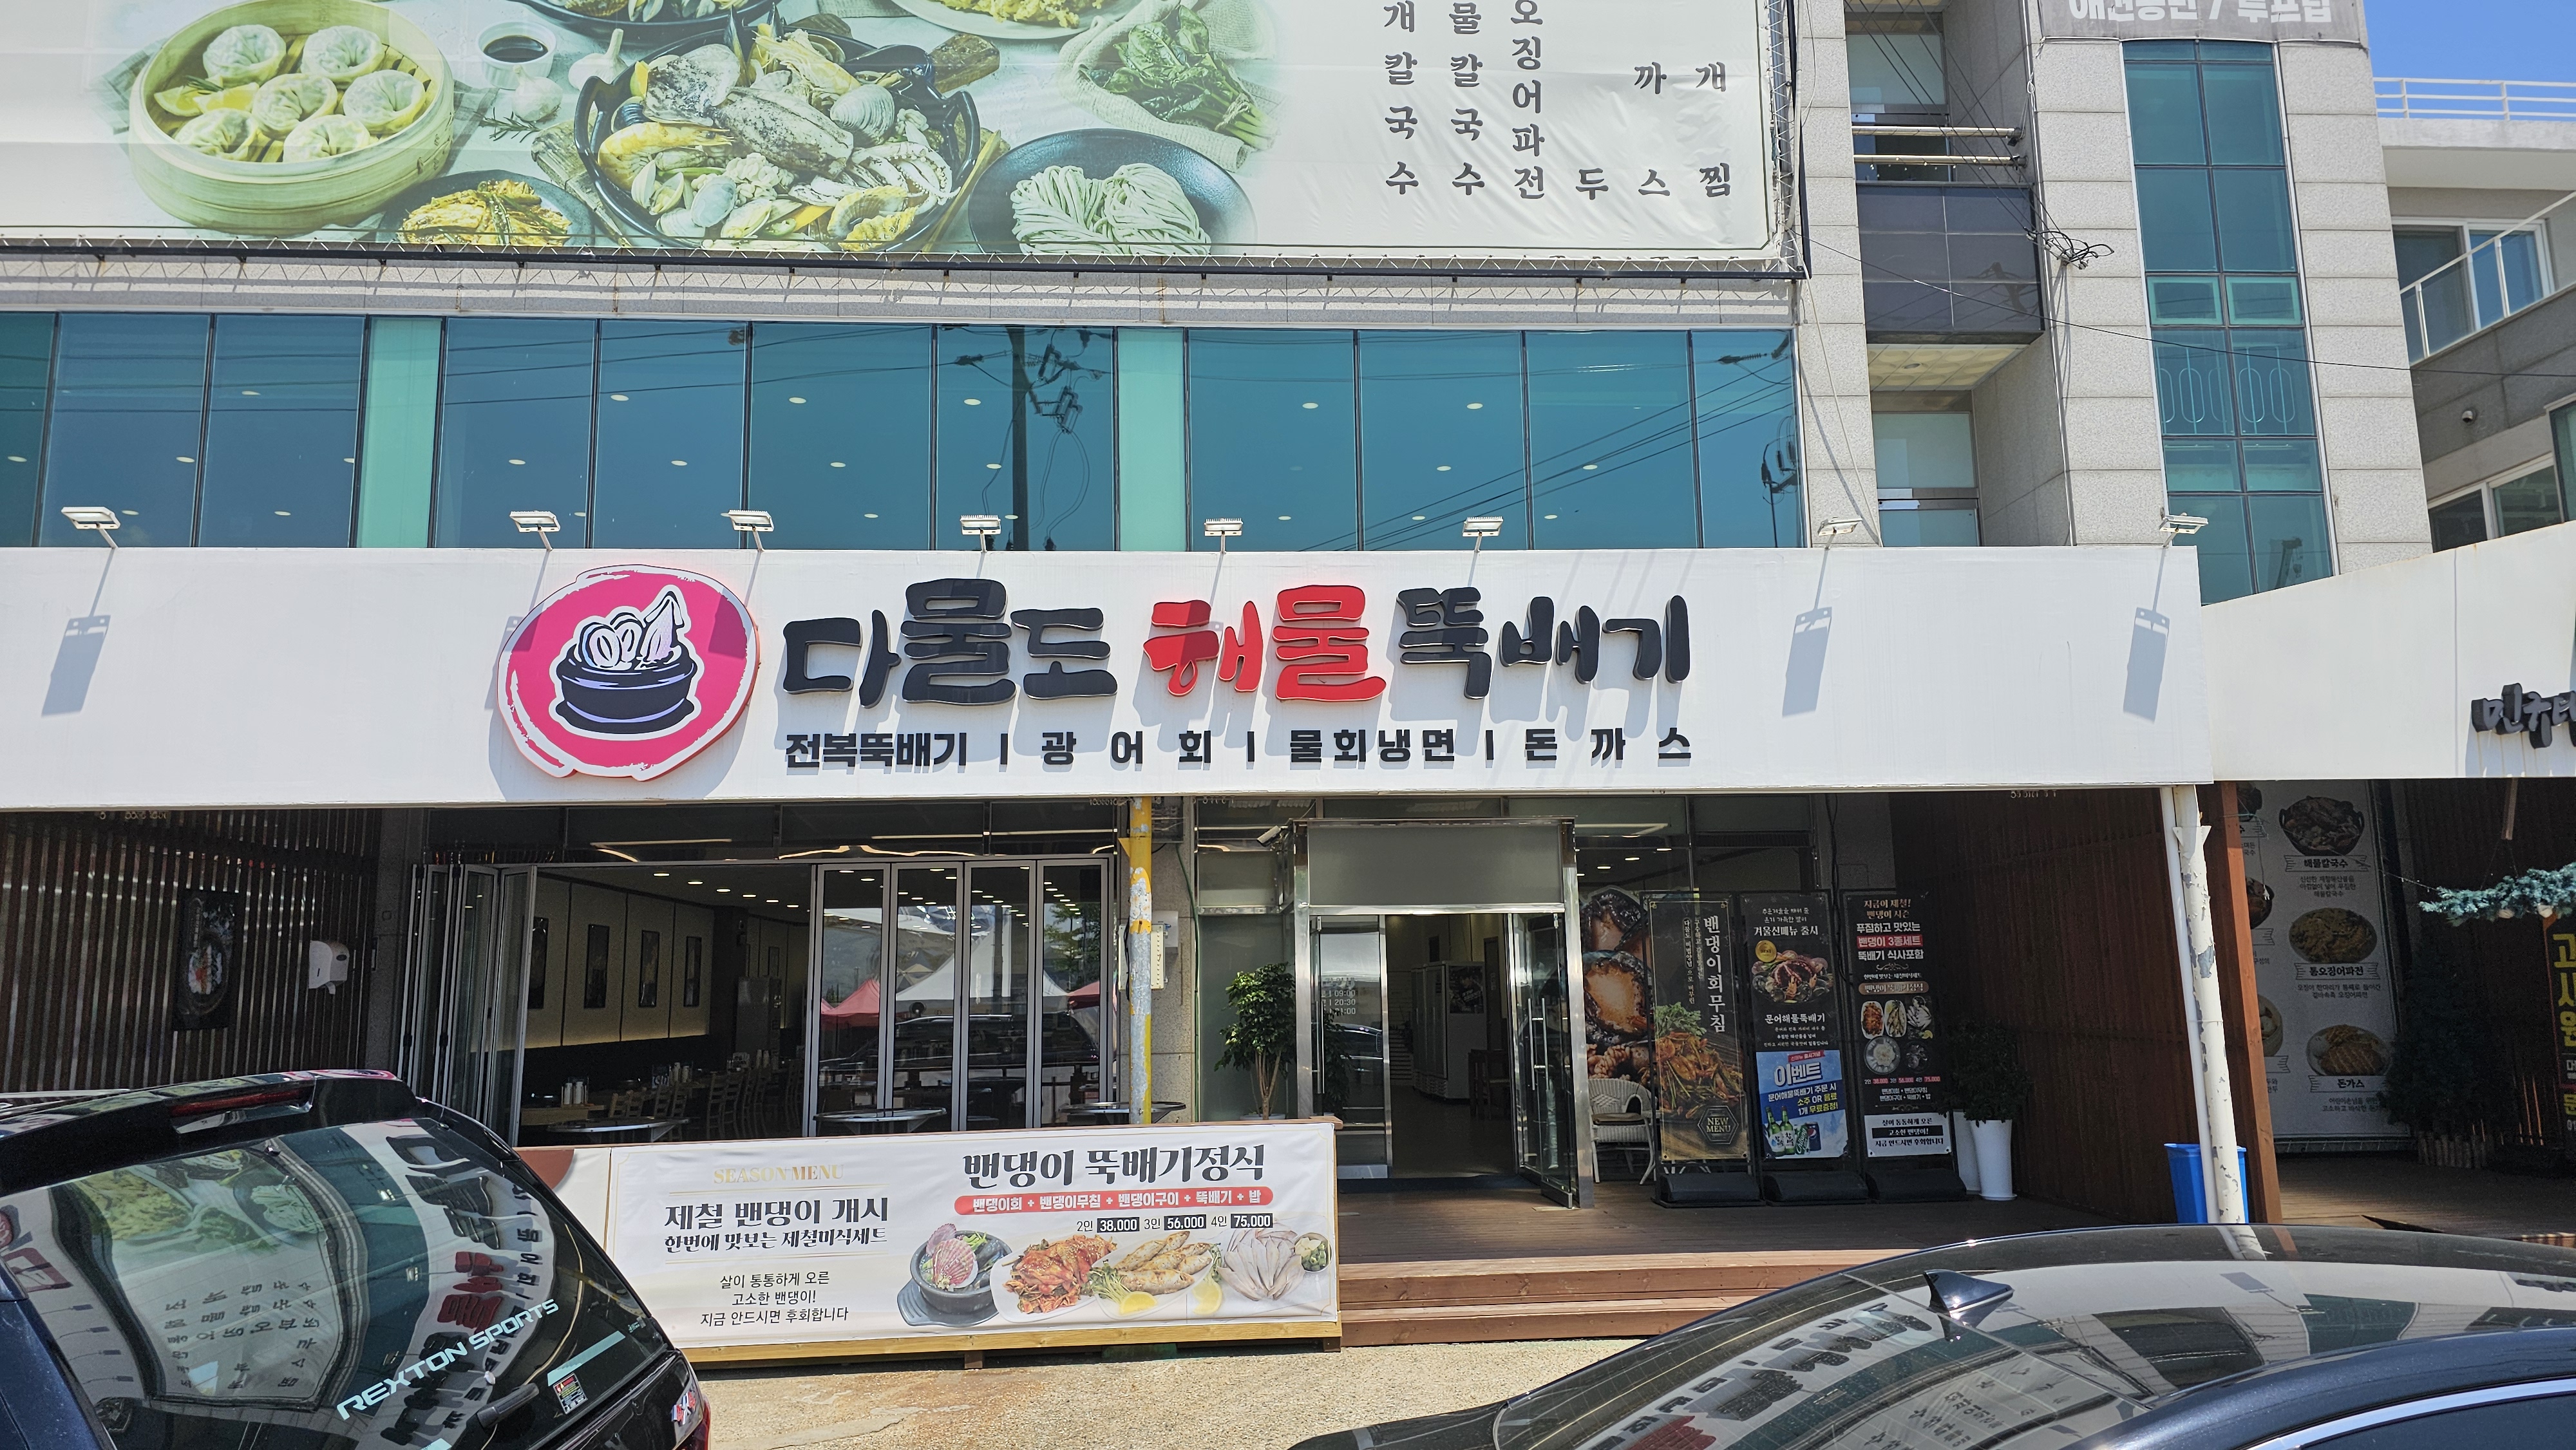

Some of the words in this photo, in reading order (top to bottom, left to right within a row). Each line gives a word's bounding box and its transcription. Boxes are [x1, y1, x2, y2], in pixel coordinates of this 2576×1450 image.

[782, 577, 1118, 710] 다물도
[784, 731, 968, 769] 전복뚝배기
[2304, 858, 2349, 869] 해물칼국수
[1857, 923, 1892, 934] 푸짐하고
[1893, 921, 1921, 932] 맛있는
[1858, 936, 1886, 947] 밴댕이
[1888, 936, 1922, 946] 3종세트
[1858, 950, 1885, 961] 뚝배기
[1887, 949, 1924, 960] 식사포함
[1703, 915, 1726, 1033] 밴댕이회무침
[2309, 966, 2364, 976] 통오징어파전
[1765, 1013, 1825, 1024] 문어해물뚝배기
[1774, 1062, 1823, 1086] 이벤트
[1814, 1084, 1828, 1094] 주문
[1829, 1083, 1837, 1091] 시
[2337, 1078, 2365, 1089] 돈가스
[1797, 1097, 1810, 1107] 소주
[1812, 1095, 1823, 1104] OR
[1798, 1106, 1808, 1116] 1개
[1707, 1117, 1729, 1125] NEW
[714, 1166, 789, 1183] SEASON
[791, 1164, 844, 1181] MENU
[963, 1149, 1074, 1189] 밴댕이
[1084, 1144, 1265, 1185] 뚝배기정식
[972, 1198, 1022, 1213] 밴댕이회
[1039, 1195, 1101, 1210] 밴댕이무침
[1118, 1192, 1179, 1209] 밴댕이구이
[1195, 1191, 1233, 1205] 뚝배기
[1249, 1190, 1262, 1204] 밥
[664, 1203, 723, 1230] 제철
[735, 1199, 820, 1228] 밴댕이
[831, 1196, 888, 1223] 개시
[1076, 1220, 1094, 1232] 2인
[1099, 1218, 1138, 1232] 38,000
[1144, 1218, 1161, 1230] 3인
[1166, 1216, 1205, 1229] 56,000
[1211, 1216, 1227, 1228] 4인
[1233, 1214, 1271, 1228] 75,000
[664, 1233, 720, 1254] 한번에
[724, 1231, 777, 1251] 맛보는
[781, 1227, 888, 1248] 제철미식세트
[719, 1274, 745, 1289] 살이
[750, 1272, 800, 1288] 통통하게
[804, 1270, 830, 1286] 오른
[732, 1292, 770, 1306] 고소한
[775, 1290, 816, 1305] 밴댕이!
[700, 1312, 726, 1328] 지금
[731, 1310, 781, 1326] 안드시면
[785, 1306, 849, 1324] 후회합니다
[337, 1342, 468, 1420] REXTON
[469, 1298, 559, 1350] SPORTS
